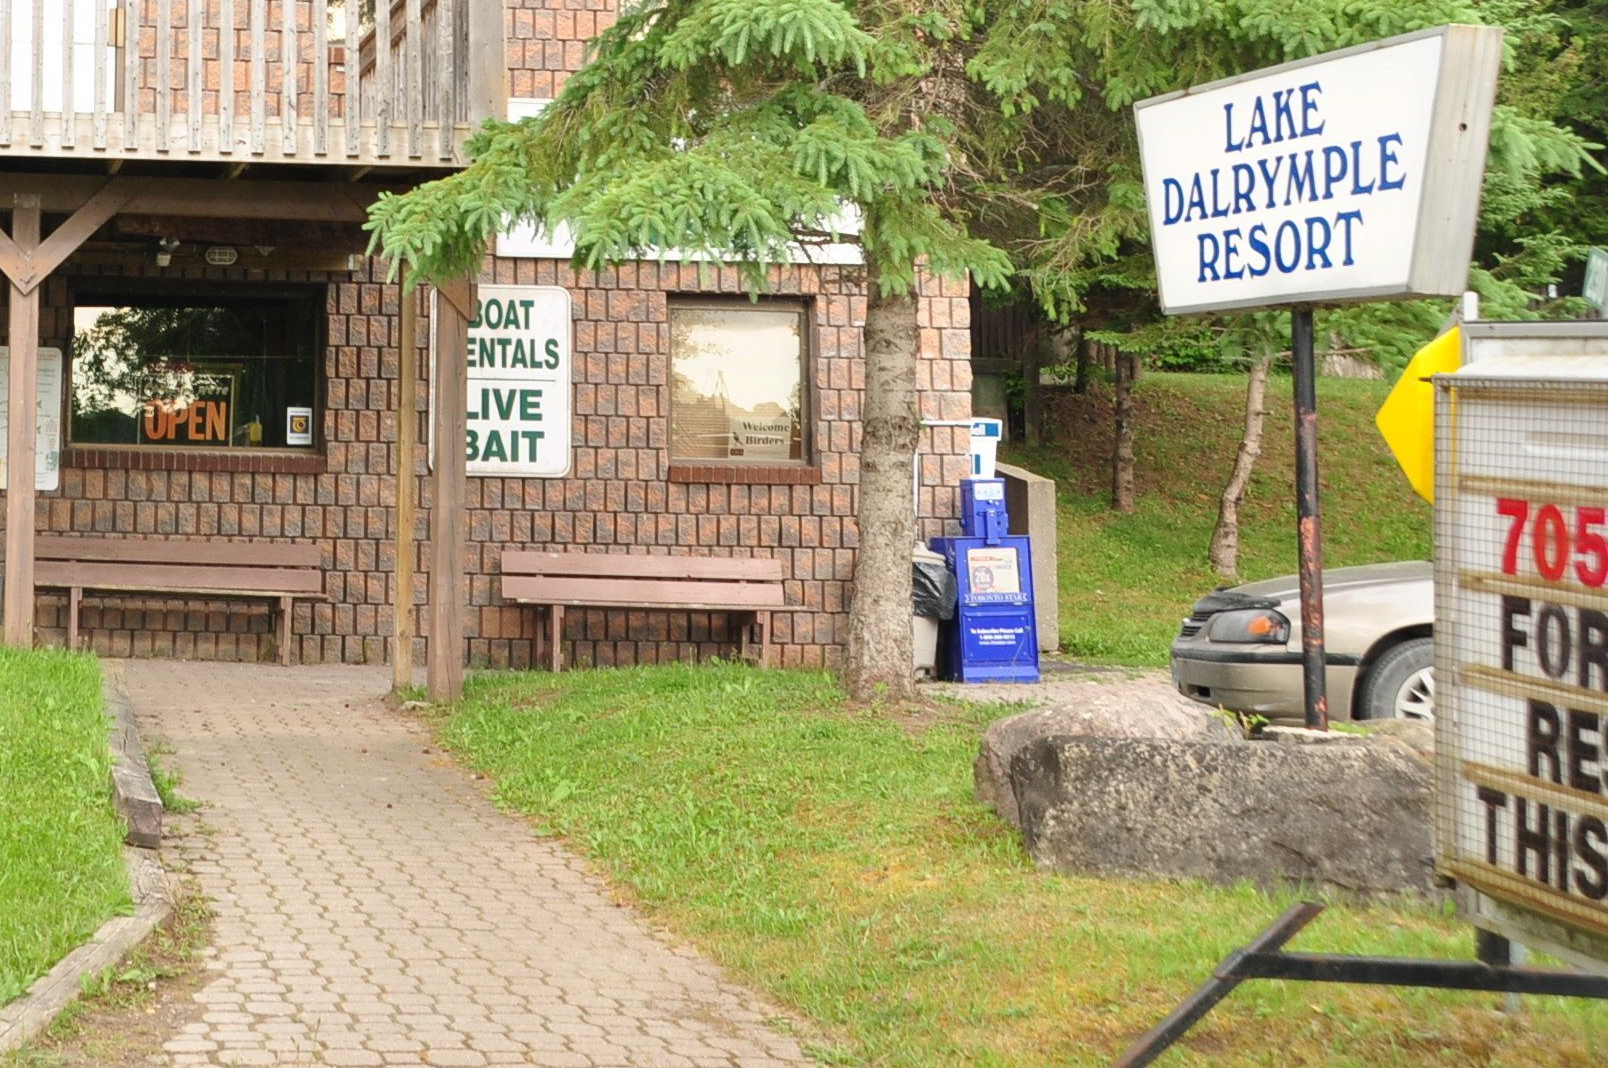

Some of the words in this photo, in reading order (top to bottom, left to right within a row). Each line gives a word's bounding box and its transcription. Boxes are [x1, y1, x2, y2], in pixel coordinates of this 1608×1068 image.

[1223, 81, 1326, 153] LAKE
[1162, 132, 1407, 226] DALRYMPLE
[1197, 209, 1364, 283] RESORT
[467, 337, 560, 370] ENTALS
[144, 398, 227, 441] OPEN
[742, 421, 790, 432] Welcome
[745, 435, 784, 445] Birders
[1496, 497, 1608, 588] 705
[970, 594, 1003, 603] TORONTO
[1005, 593, 1024, 602] STAR
[1501, 593, 1608, 689] FOR
[1476, 785, 1608, 901] THIS
